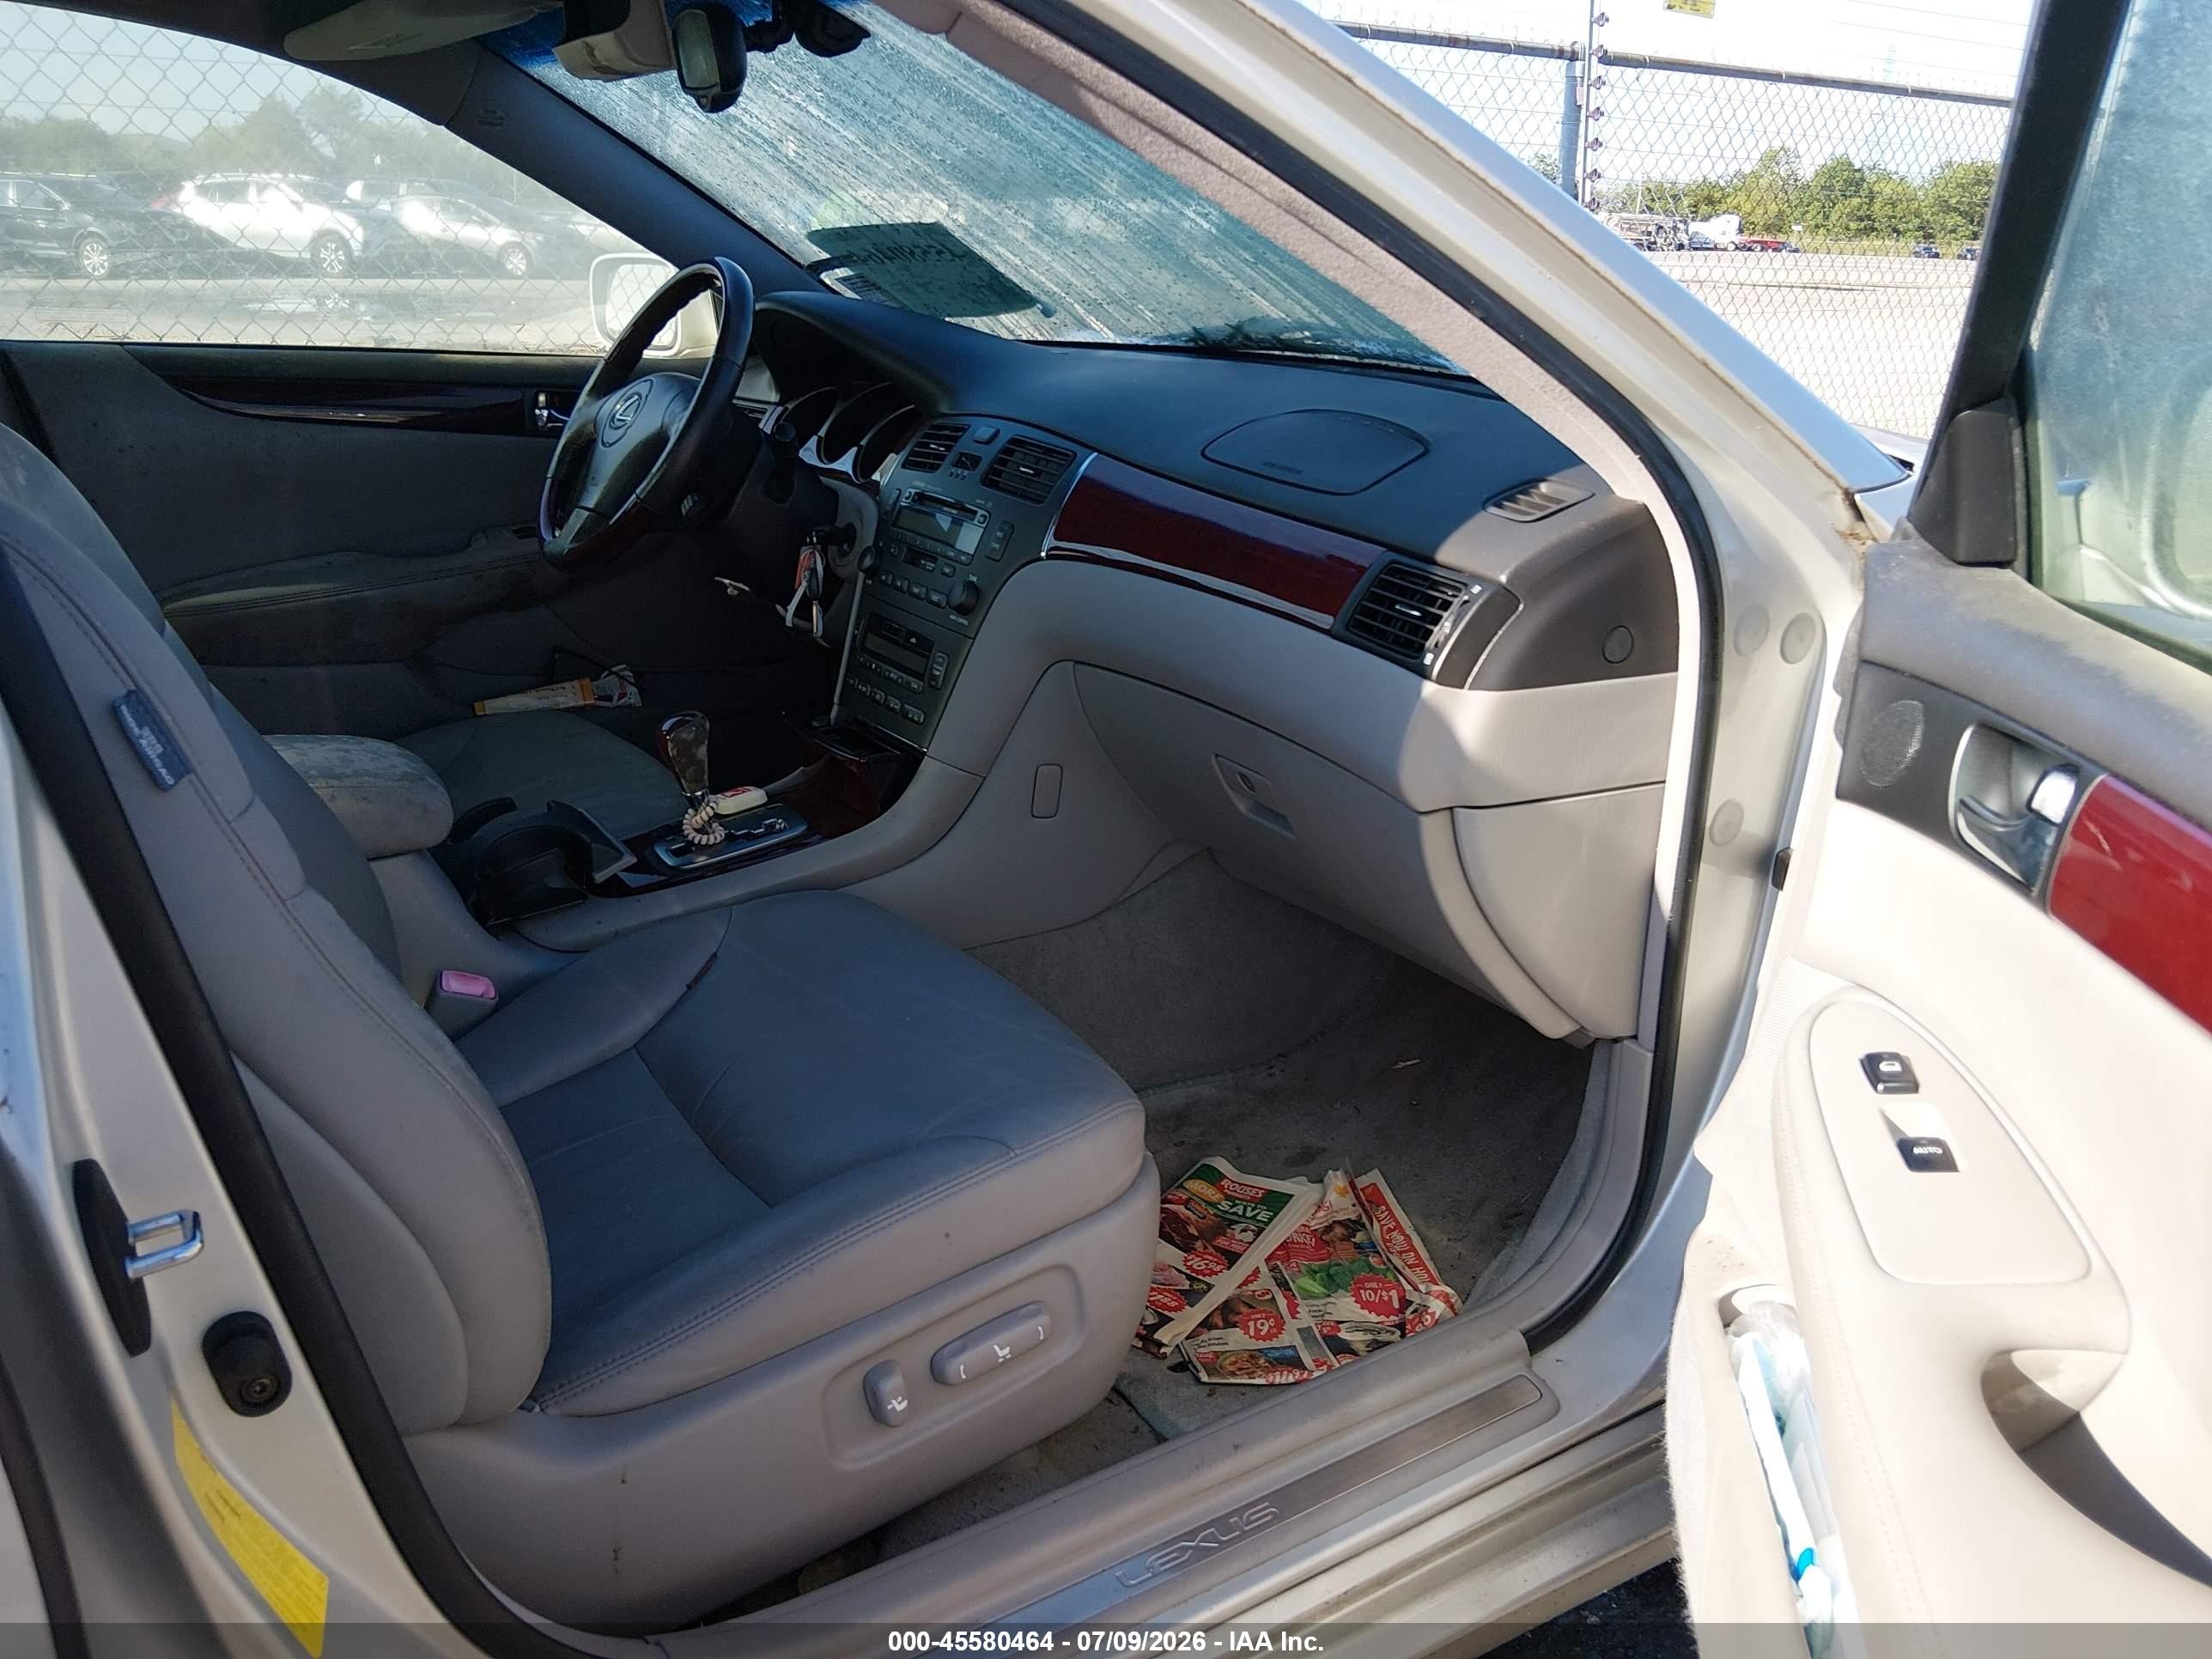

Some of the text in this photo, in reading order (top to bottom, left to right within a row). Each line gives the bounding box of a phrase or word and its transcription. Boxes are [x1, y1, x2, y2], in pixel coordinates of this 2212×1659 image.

[1912, 1146, 1943, 1155] AUTO
[1189, 1181, 1224, 1202] MORE
[1220, 1178, 1265, 1198] ROUSES
[1216, 1200, 1274, 1222] SAVE
[1375, 1205, 1396, 1231] SAVE
[1401, 1251, 1419, 1267] ON
[1359, 1289, 1400, 1309] 10/$1
[1114, 1502, 1279, 1587] LEXUS
